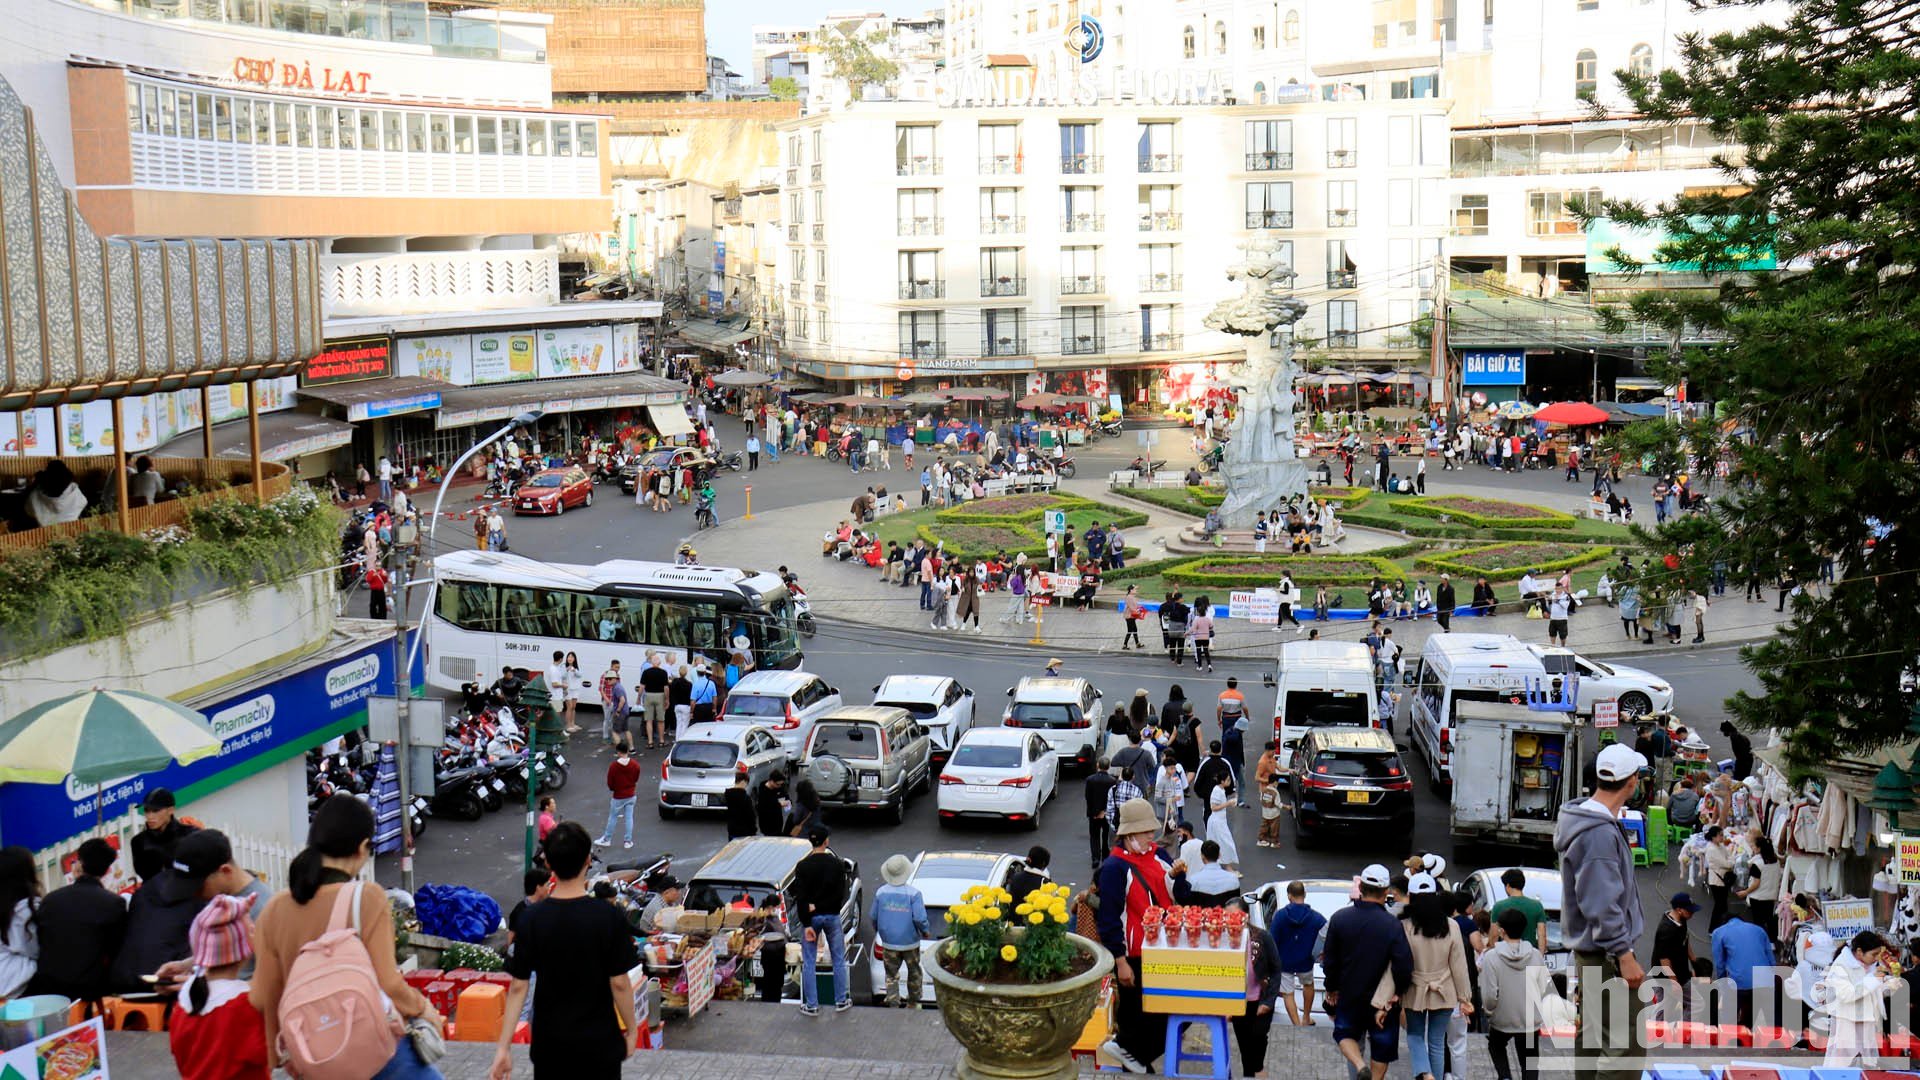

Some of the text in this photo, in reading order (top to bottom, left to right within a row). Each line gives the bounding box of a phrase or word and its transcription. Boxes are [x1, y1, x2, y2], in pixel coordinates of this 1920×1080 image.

[234, 56, 372, 96] CHỢ ĐÀ LẠT
[1467, 353, 1521, 373] BÃI GIỮ XE
[329, 659, 376, 690] Pharmacity
[1467, 678, 1522, 687] LUXUR
[214, 701, 271, 735] Pharmacity
[73, 800, 93, 818] Nhà
[117, 785, 134, 800] tiện
[133, 778, 145, 794] lợi
